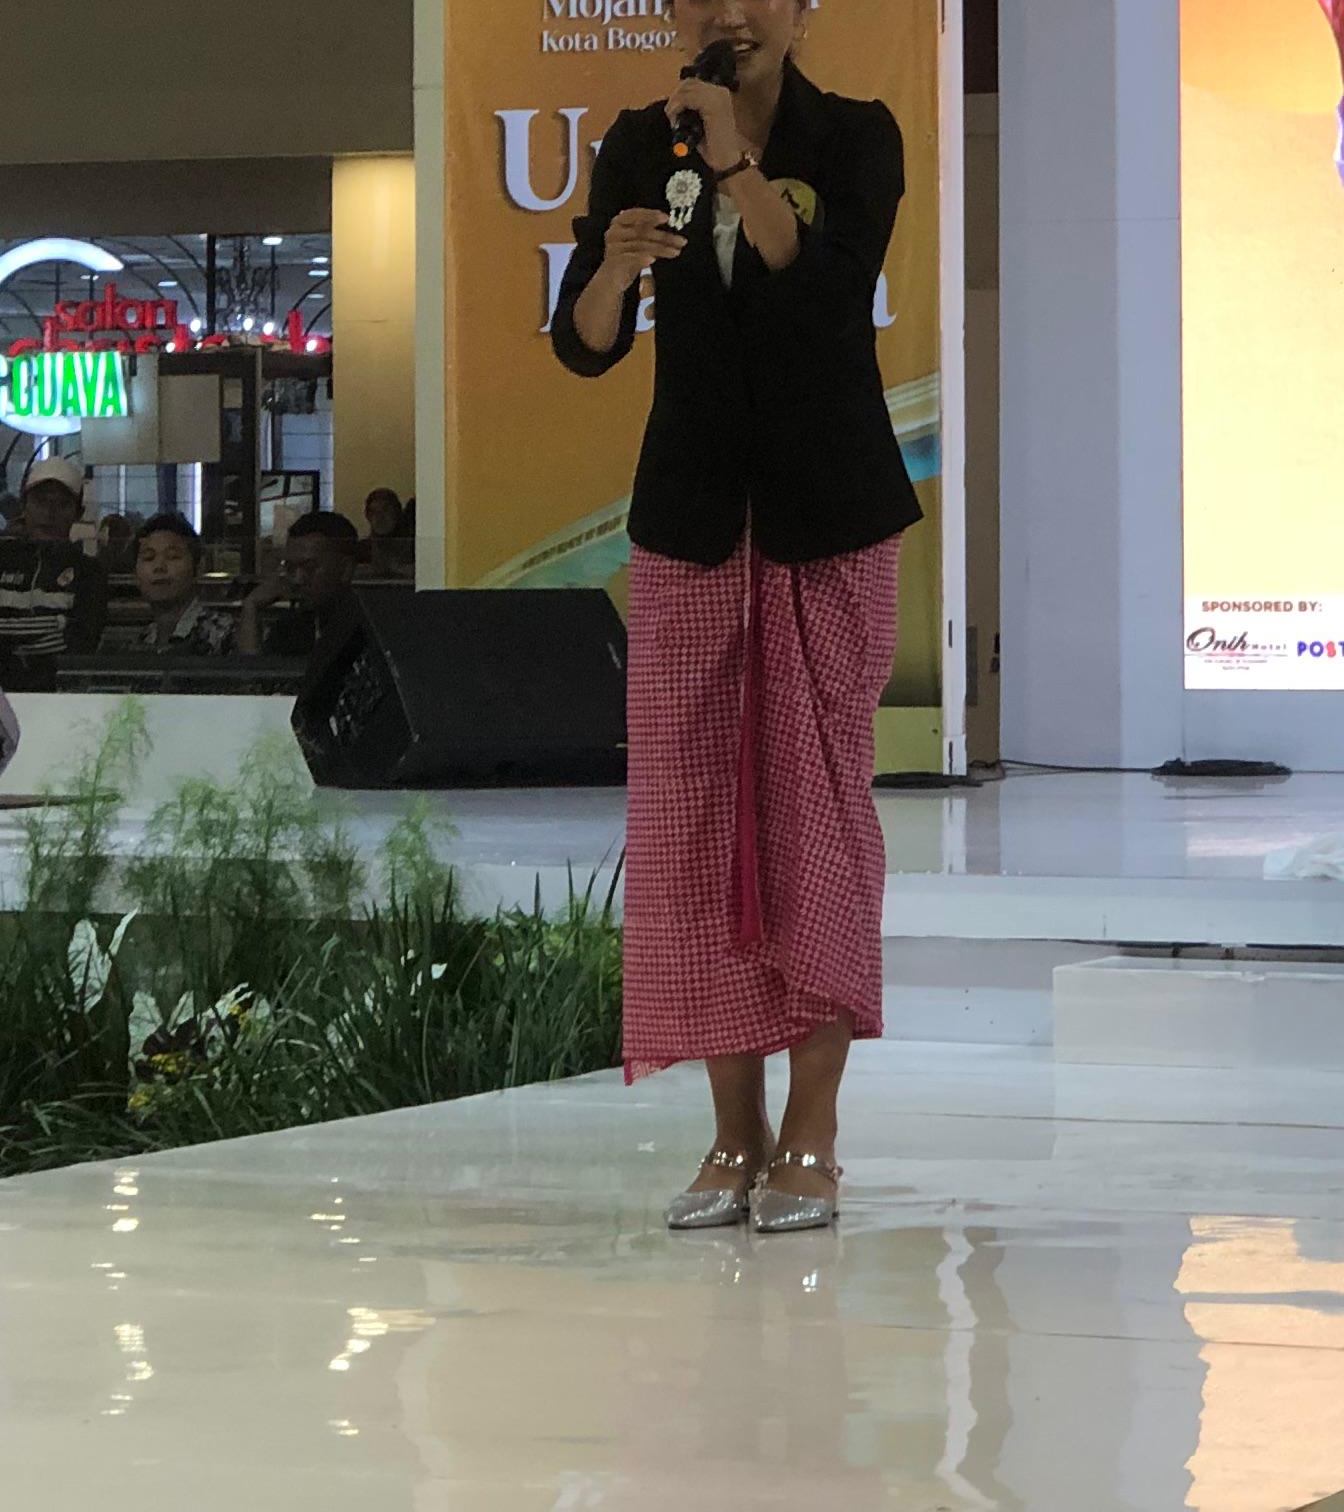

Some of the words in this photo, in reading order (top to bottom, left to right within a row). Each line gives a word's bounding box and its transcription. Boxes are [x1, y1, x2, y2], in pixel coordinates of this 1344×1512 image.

[542, 28, 598, 53] Kota
[56, 281, 178, 332] salon
[12, 350, 128, 419] GUAVA
[1201, 600, 1294, 613] SPONSORED
[1298, 600, 1323, 613] BY:
